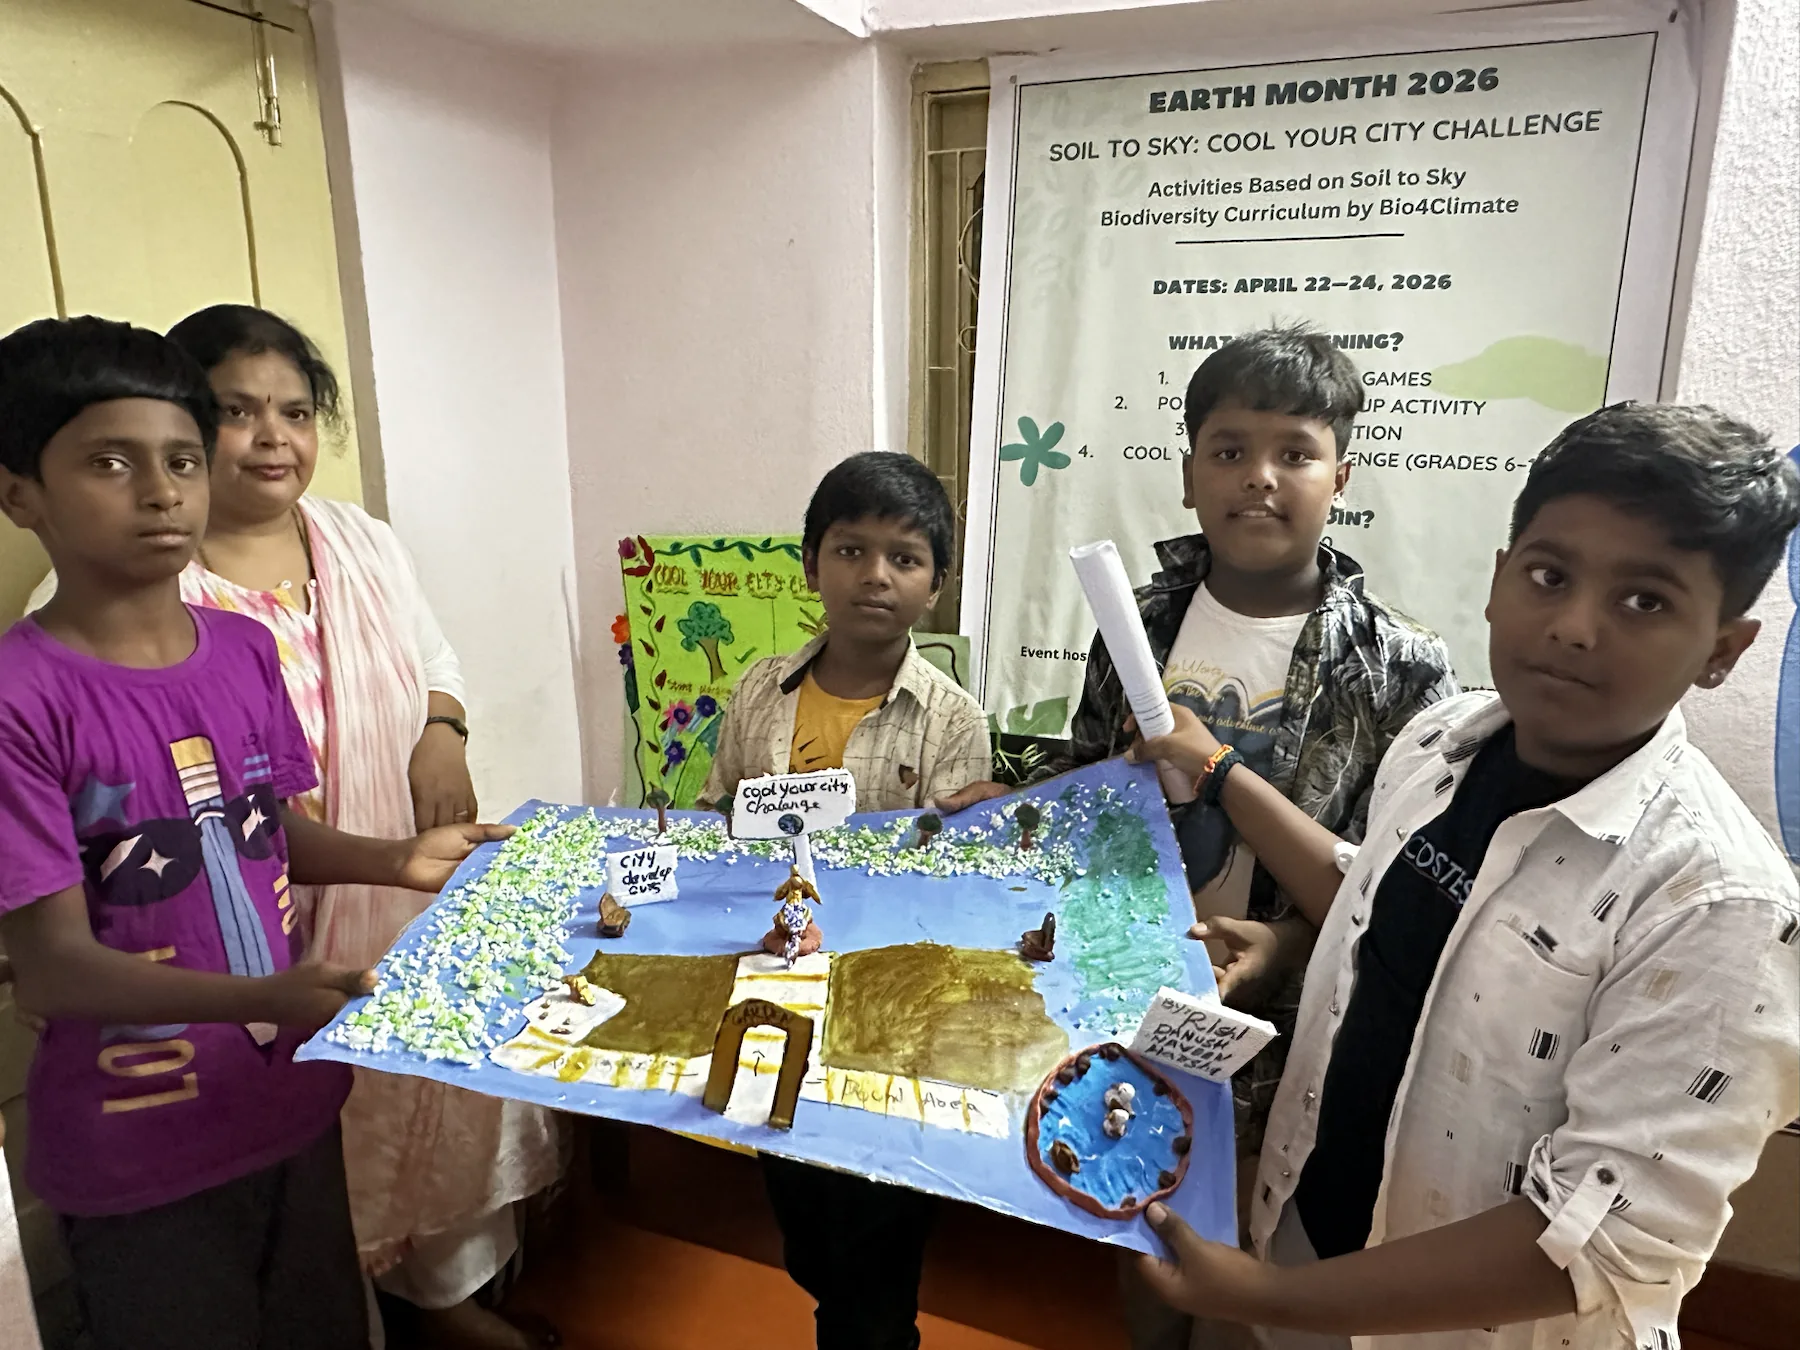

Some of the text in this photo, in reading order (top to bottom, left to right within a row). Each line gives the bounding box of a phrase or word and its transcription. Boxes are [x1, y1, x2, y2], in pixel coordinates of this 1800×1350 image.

[1149, 67, 1500, 114] EARTH MONTH 2026
[1049, 109, 1603, 162] SOIL TO SKY: COOL YOUR CITY CHALLENGE
[1148, 167, 1467, 199] Activities Based on Soil to Sky
[1101, 196, 1520, 228] Biodiversity Curriculum by Bio4Climate
[1152, 279, 1228, 295] DATES:
[1234, 277, 1298, 294] APRIL
[1391, 273, 1453, 291] 2026
[1157, 371, 1433, 387] 1. GAMES
[1114, 396, 1128, 410] 2.
[1390, 399, 1487, 416] ACTIVITY
[1350, 425, 1403, 441] TION
[1078, 444, 1095, 458] 4.
[1123, 446, 1172, 460] COOL
[1405, 454, 1498, 471] (GRADES
[1503, 456, 1537, 472] 6-
[1020, 645, 1060, 660] Event
